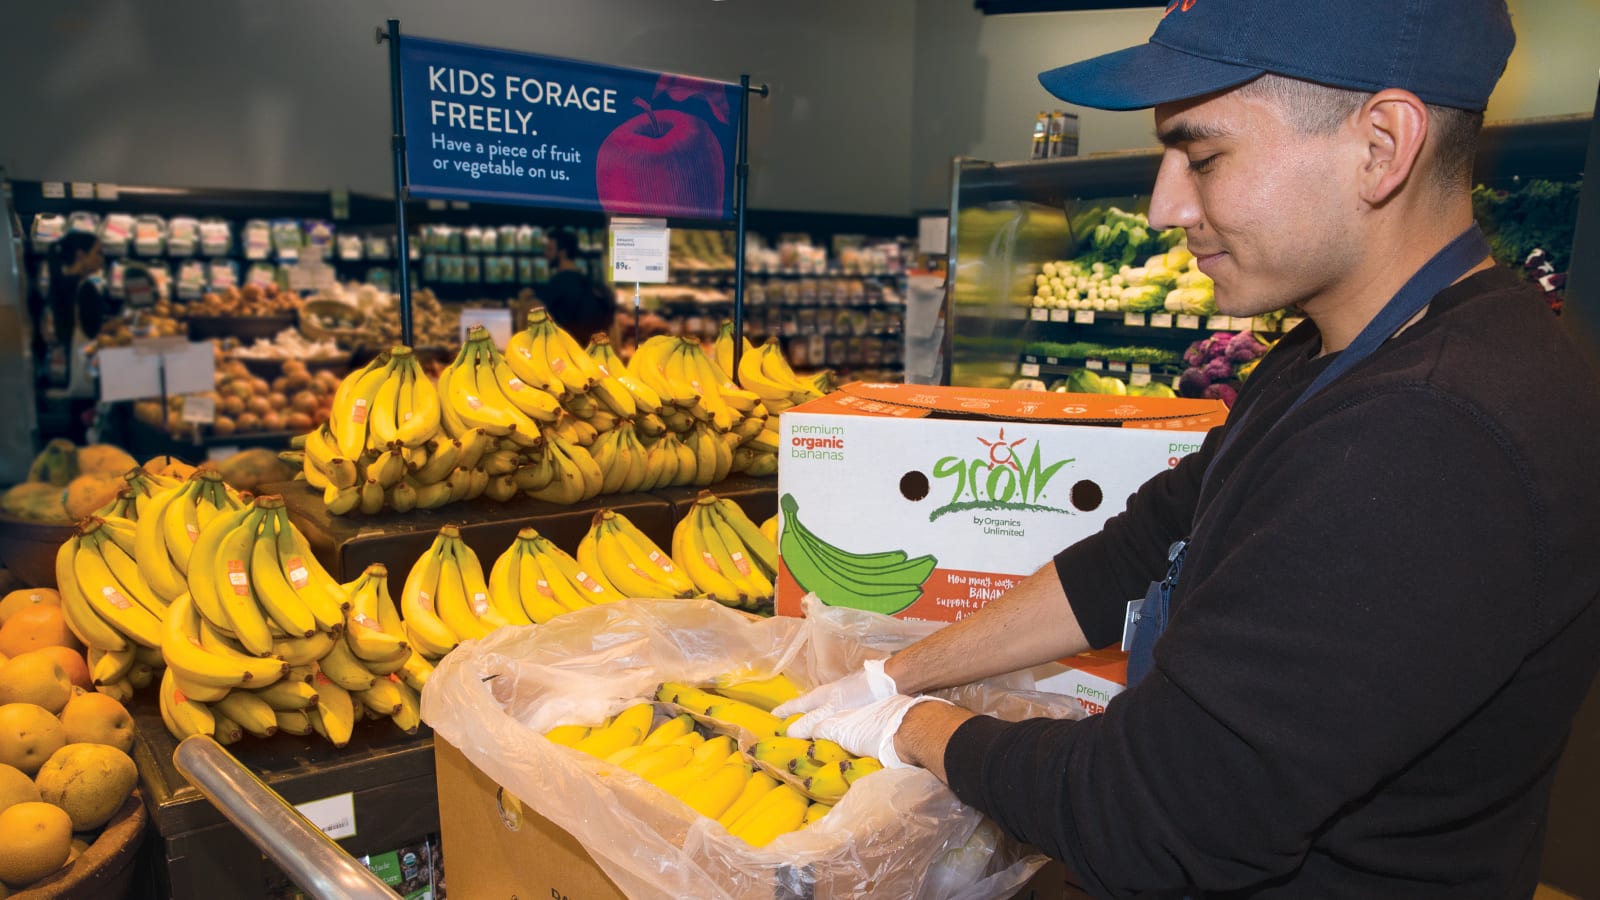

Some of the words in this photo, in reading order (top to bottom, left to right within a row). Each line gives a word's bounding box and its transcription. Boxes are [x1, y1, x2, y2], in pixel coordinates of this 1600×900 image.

[429, 65, 496, 98] KIDS
[505, 76, 617, 113] FORAGE
[430, 100, 538, 136] FREELY.
[431, 132, 471, 153] Have
[476, 142, 484, 154] a
[488, 140, 528, 161] piece
[531, 144, 548, 160] of
[550, 145, 582, 164] fruit
[433, 158, 450, 170] or
[453, 160, 524, 179] vegetable
[528, 168, 547, 179] on
[550, 169, 571, 181] us.
[791, 424, 844, 435] premium
[791, 435, 844, 450] organic
[791, 446, 844, 461] bananas
[973, 516, 984, 526] by
[984, 517, 1021, 528] Organics
[983, 527, 1025, 537] Unlimited
[947, 574, 967, 585] How
[968, 576, 991, 588] many
